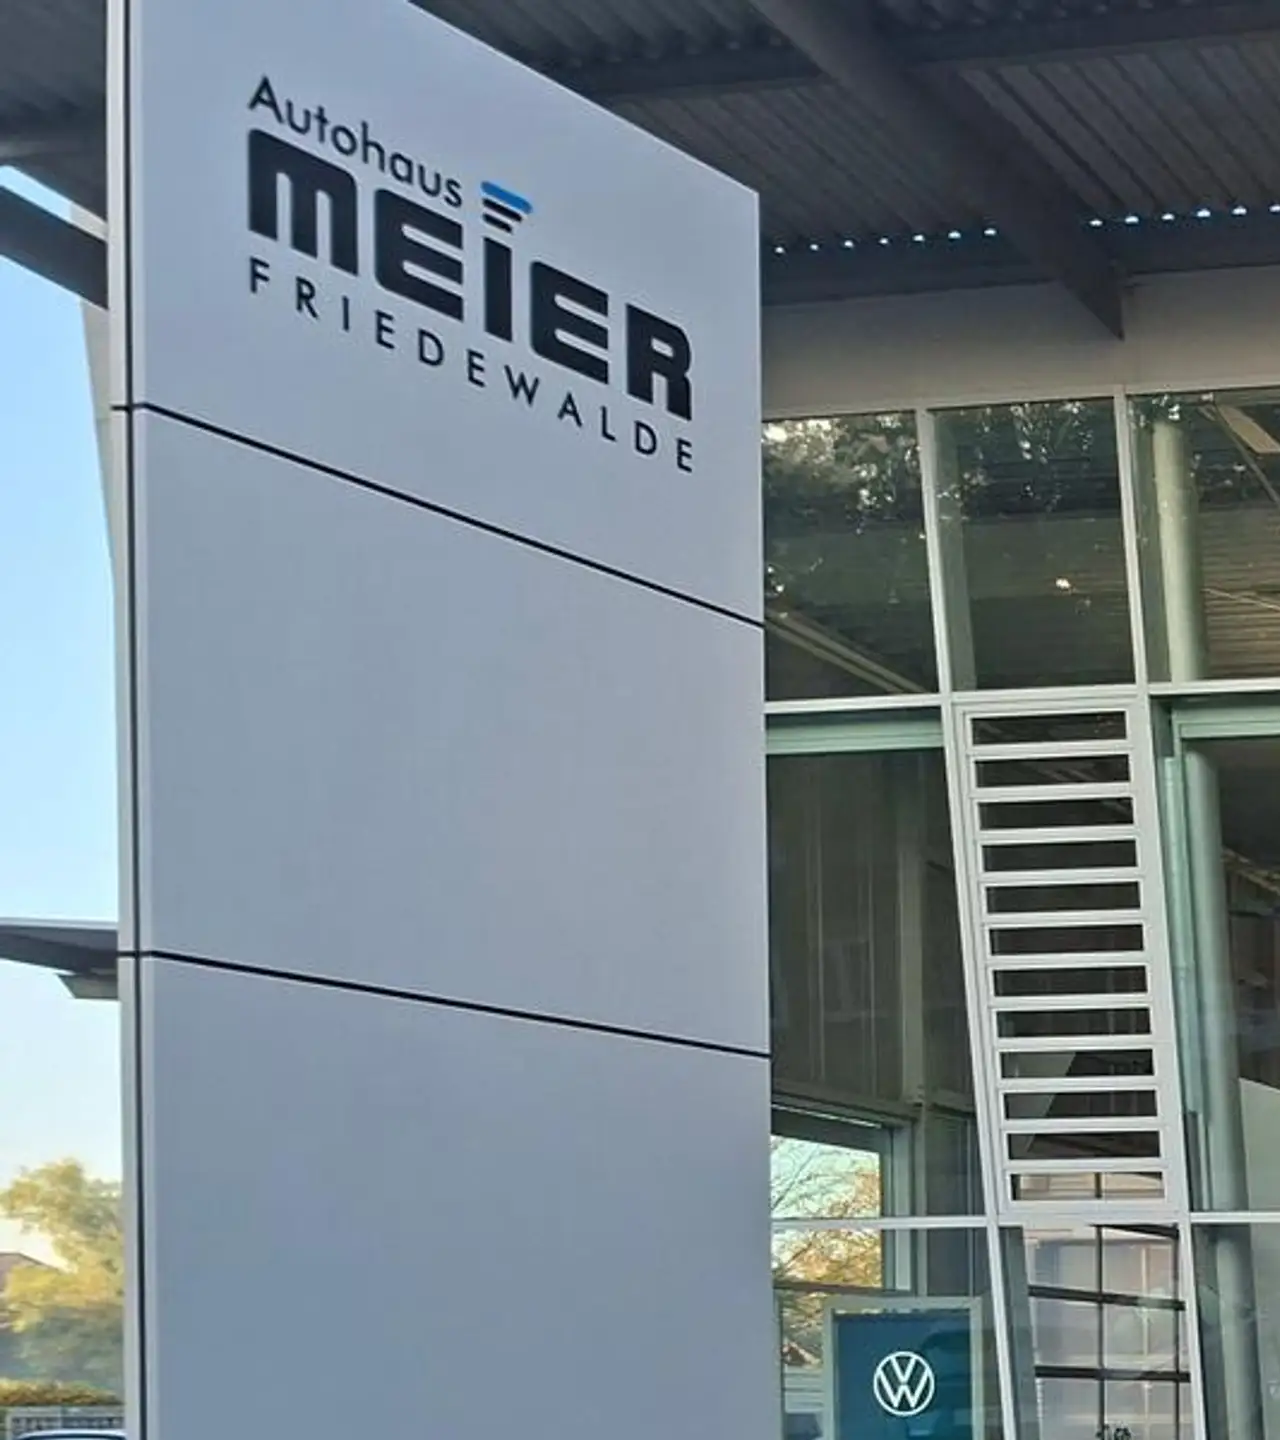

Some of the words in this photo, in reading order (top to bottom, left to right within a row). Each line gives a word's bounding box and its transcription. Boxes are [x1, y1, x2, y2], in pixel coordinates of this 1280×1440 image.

[248, 75, 463, 208] Autohaus
[247, 128, 693, 421] MEIER
[249, 257, 694, 473] FRIEDEWALDE
